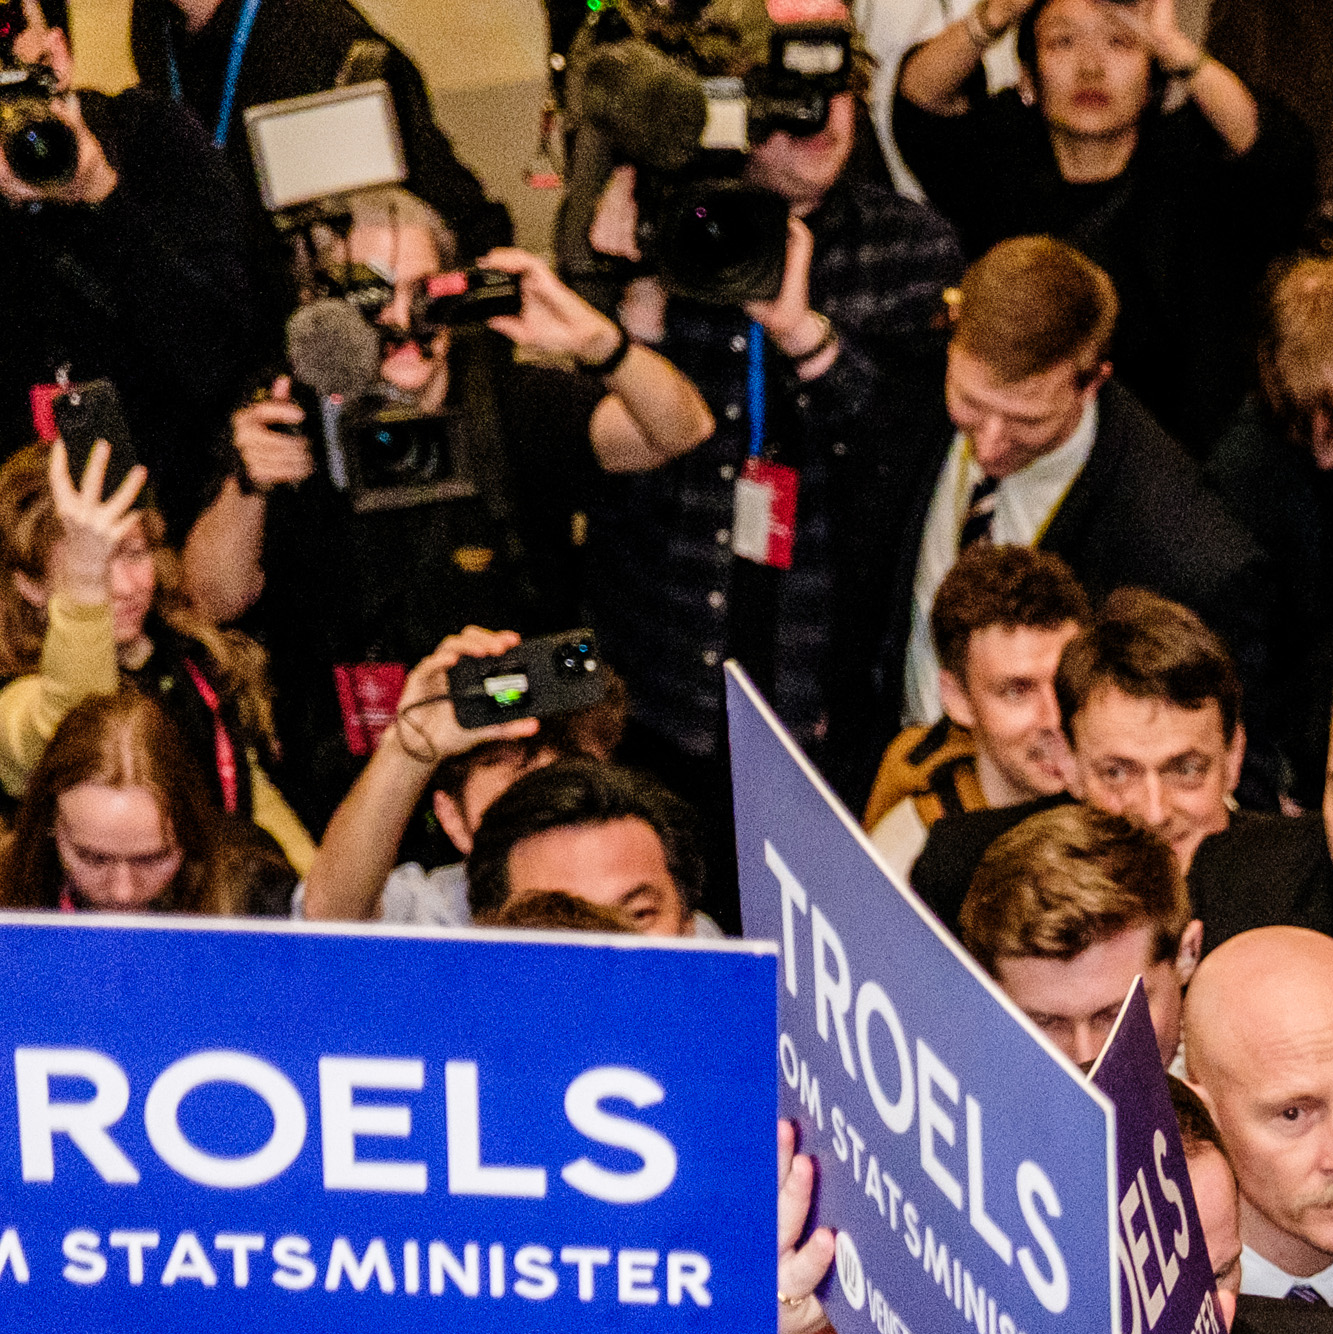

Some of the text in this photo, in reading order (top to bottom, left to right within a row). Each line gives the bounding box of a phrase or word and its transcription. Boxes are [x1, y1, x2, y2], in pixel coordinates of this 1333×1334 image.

[764, 838, 1071, 1315] TROELS
[778, 1032, 824, 1131] OM
[62, 1229, 713, 1307] STATSMINISTER
